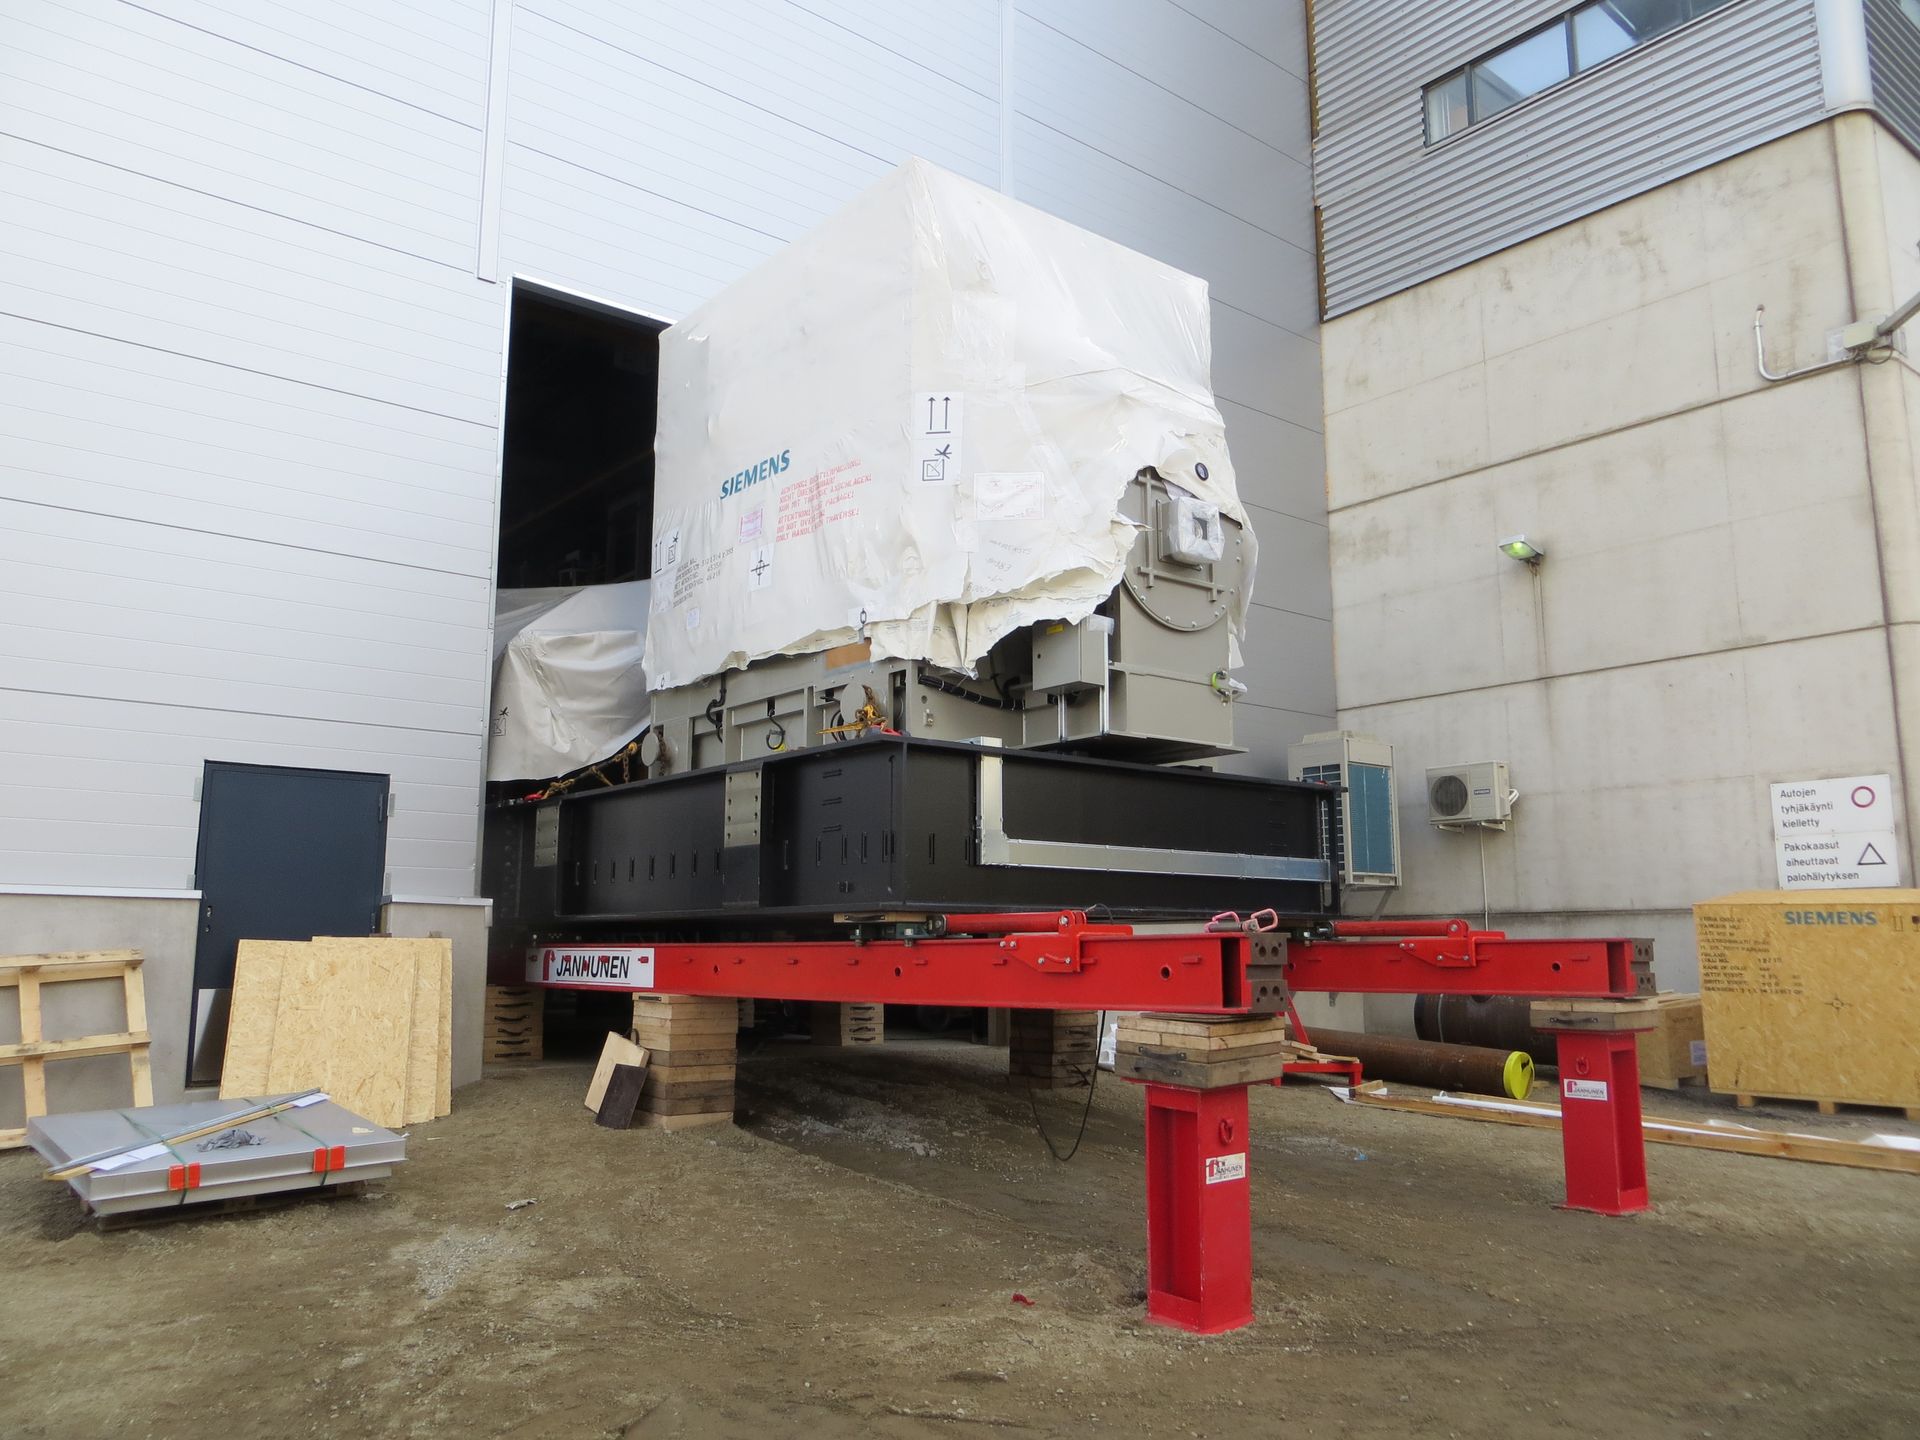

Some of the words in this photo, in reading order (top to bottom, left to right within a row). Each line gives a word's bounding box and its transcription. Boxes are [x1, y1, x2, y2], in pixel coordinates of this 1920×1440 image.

[720, 449, 790, 500] SIEMENS
[1780, 788, 1816, 798] Autojen
[1781, 801, 1833, 814] tyhjäkäynti
[1782, 818, 1820, 828] kielletty
[1784, 841, 1840, 852] Pakokaasut
[1785, 857, 1839, 867] aiheuttavat
[1787, 872, 1860, 882] palohälytyksen
[1784, 910, 1878, 925] SIEMENS
[556, 955, 630, 979] JANHUNEN
